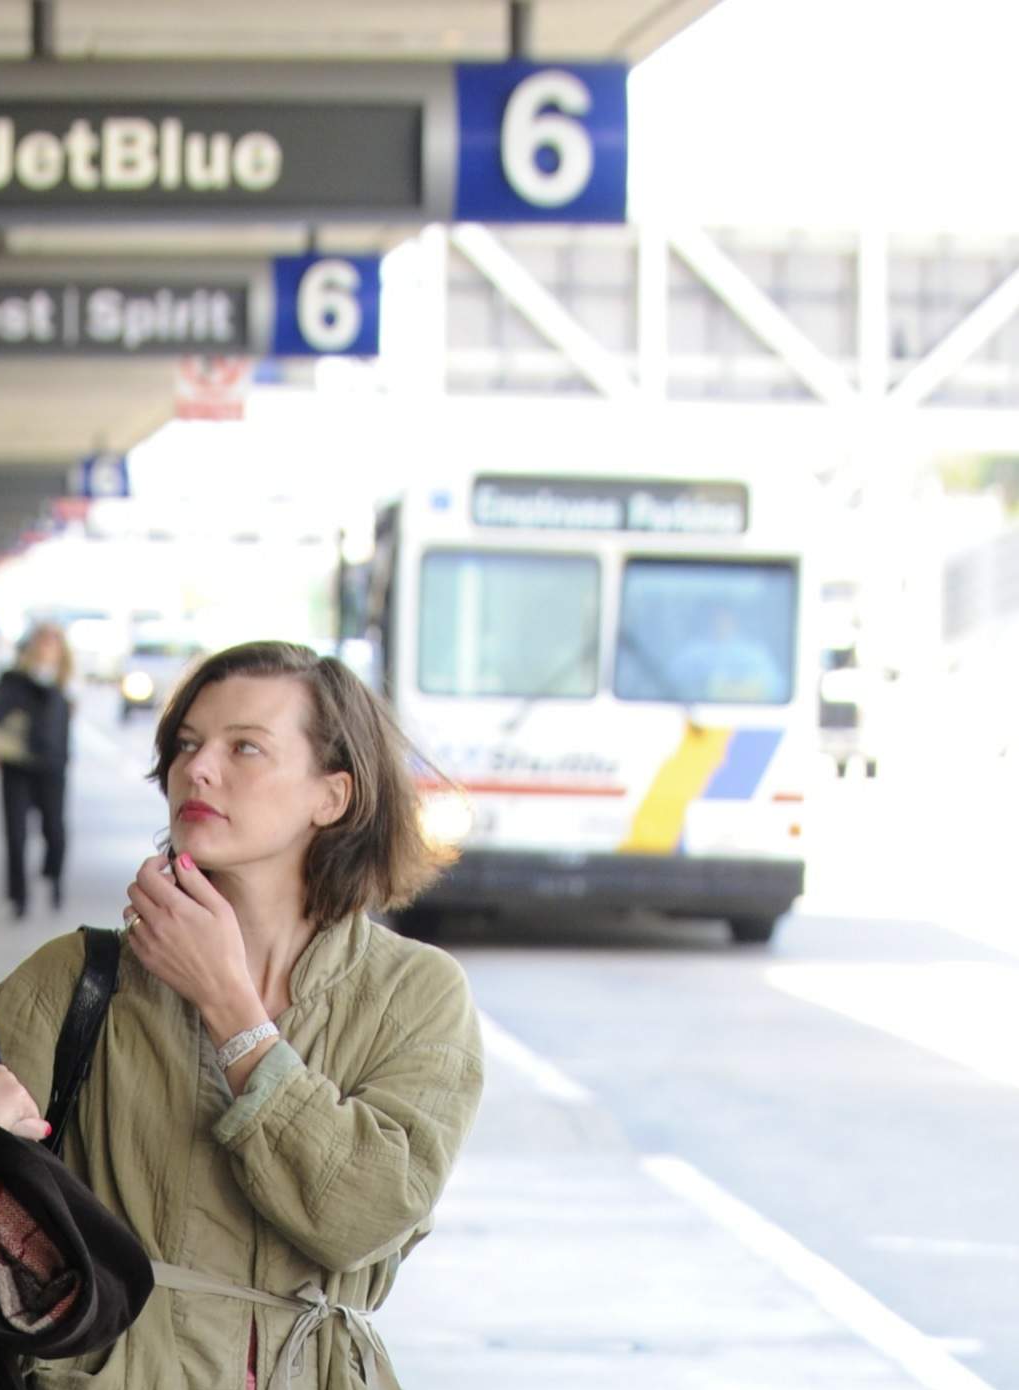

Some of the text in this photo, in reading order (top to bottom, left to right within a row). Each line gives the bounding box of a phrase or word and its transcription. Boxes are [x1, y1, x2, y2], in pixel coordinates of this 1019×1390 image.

[499, 71, 595, 207] 6
[87, 288, 235, 350] Spirit
[297, 259, 365, 353] 6
